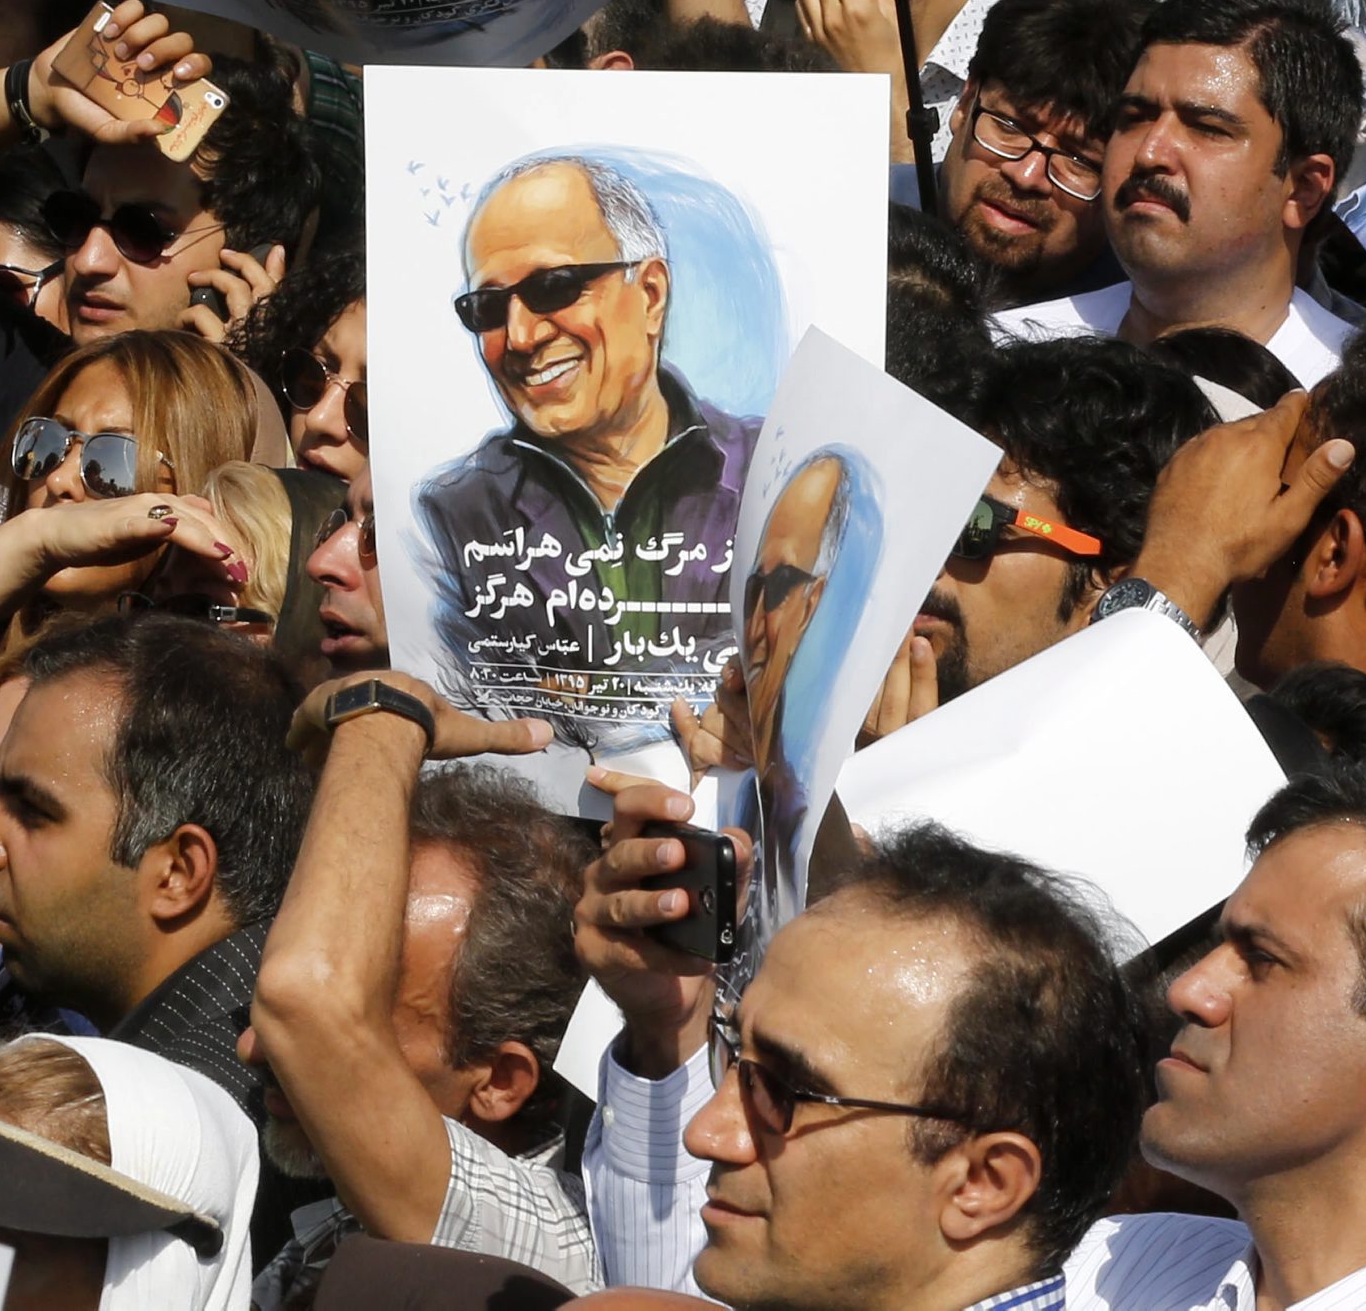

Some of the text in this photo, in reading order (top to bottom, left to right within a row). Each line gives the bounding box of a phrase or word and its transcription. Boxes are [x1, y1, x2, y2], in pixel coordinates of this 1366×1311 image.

[635, 532, 708, 575] مرگ
[711, 537, 734, 573] ز
[464, 573, 535, 619] هرگز
[468, 634, 537, 653] کیارستمی
[499, 671, 542, 683] ساعت
[554, 673, 585, 688] ۱۳۹۵
[612, 676, 625, 690] ۲۰
[588, 678, 609, 695] تیر
[501, 693, 533, 703] حجاب
[535, 696, 563, 709] خیابان
[610, 706, 618, 719] و
[619, 703, 664, 720] کودکان
